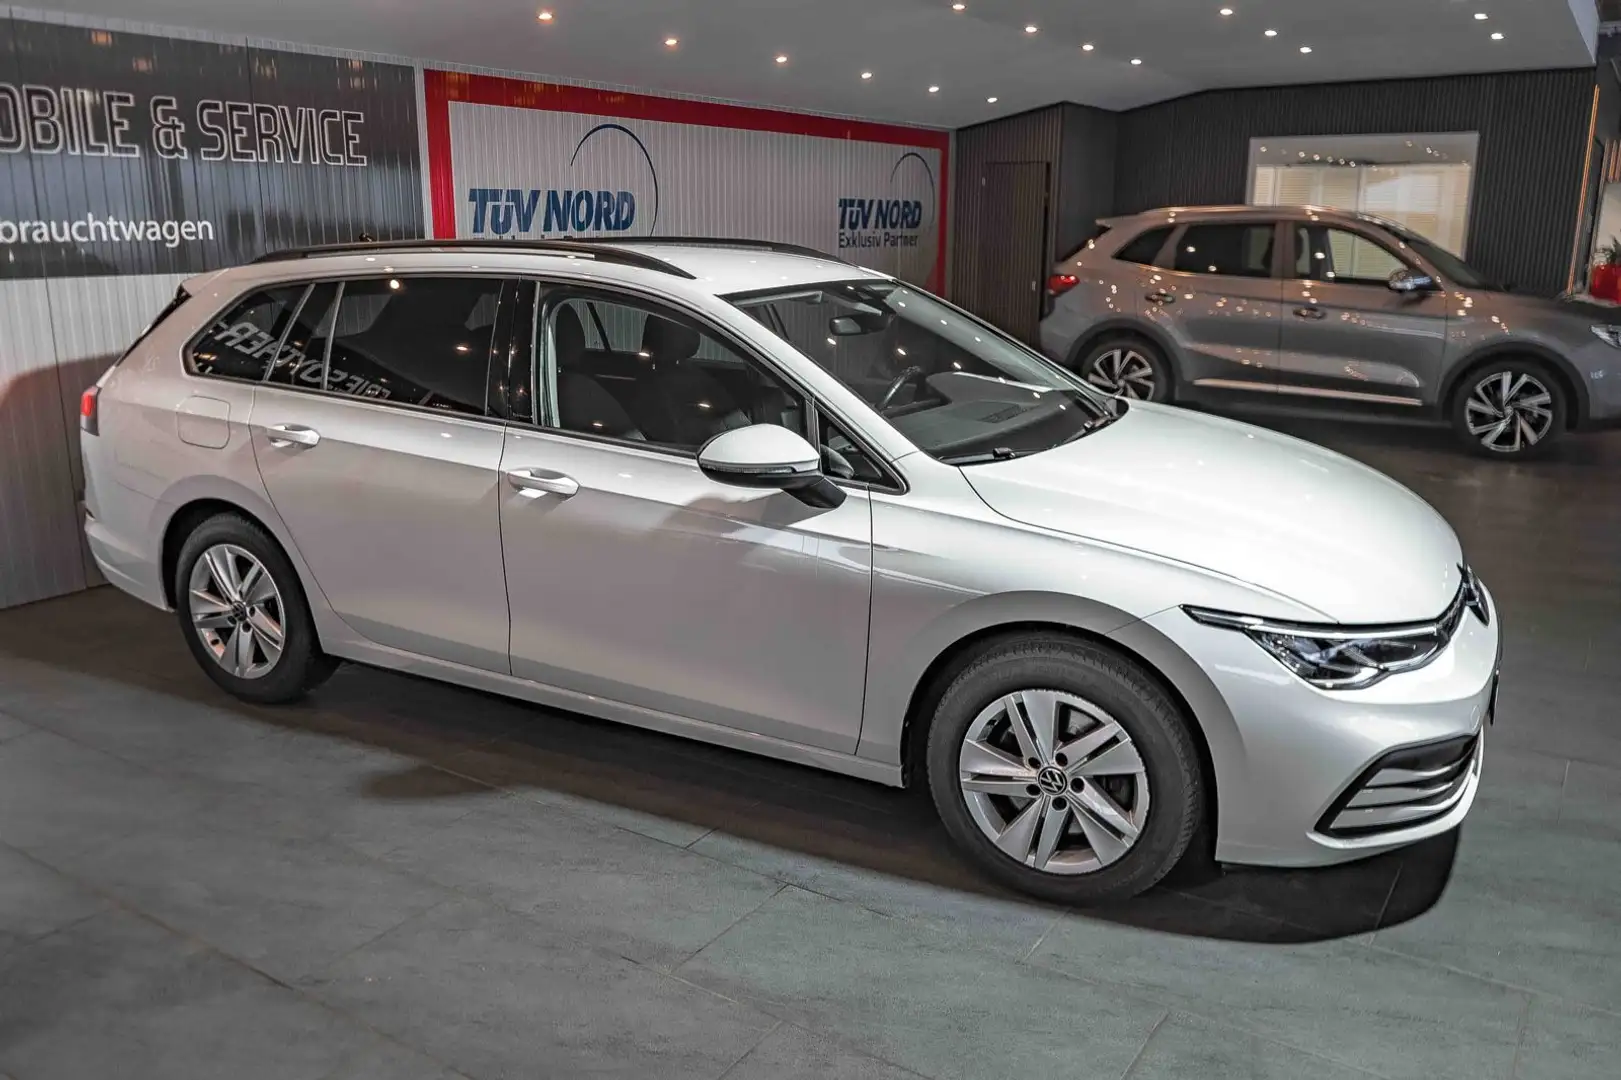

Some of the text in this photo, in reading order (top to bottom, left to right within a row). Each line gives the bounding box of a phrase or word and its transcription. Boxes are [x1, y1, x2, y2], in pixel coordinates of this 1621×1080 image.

[150, 95, 188, 159] &
[197, 99, 368, 167] SERVICE
[468, 188, 636, 235] TÜV NORD
[838, 198, 922, 230] TÜV NORD
[838, 231, 919, 248] Exklusiv Partner
